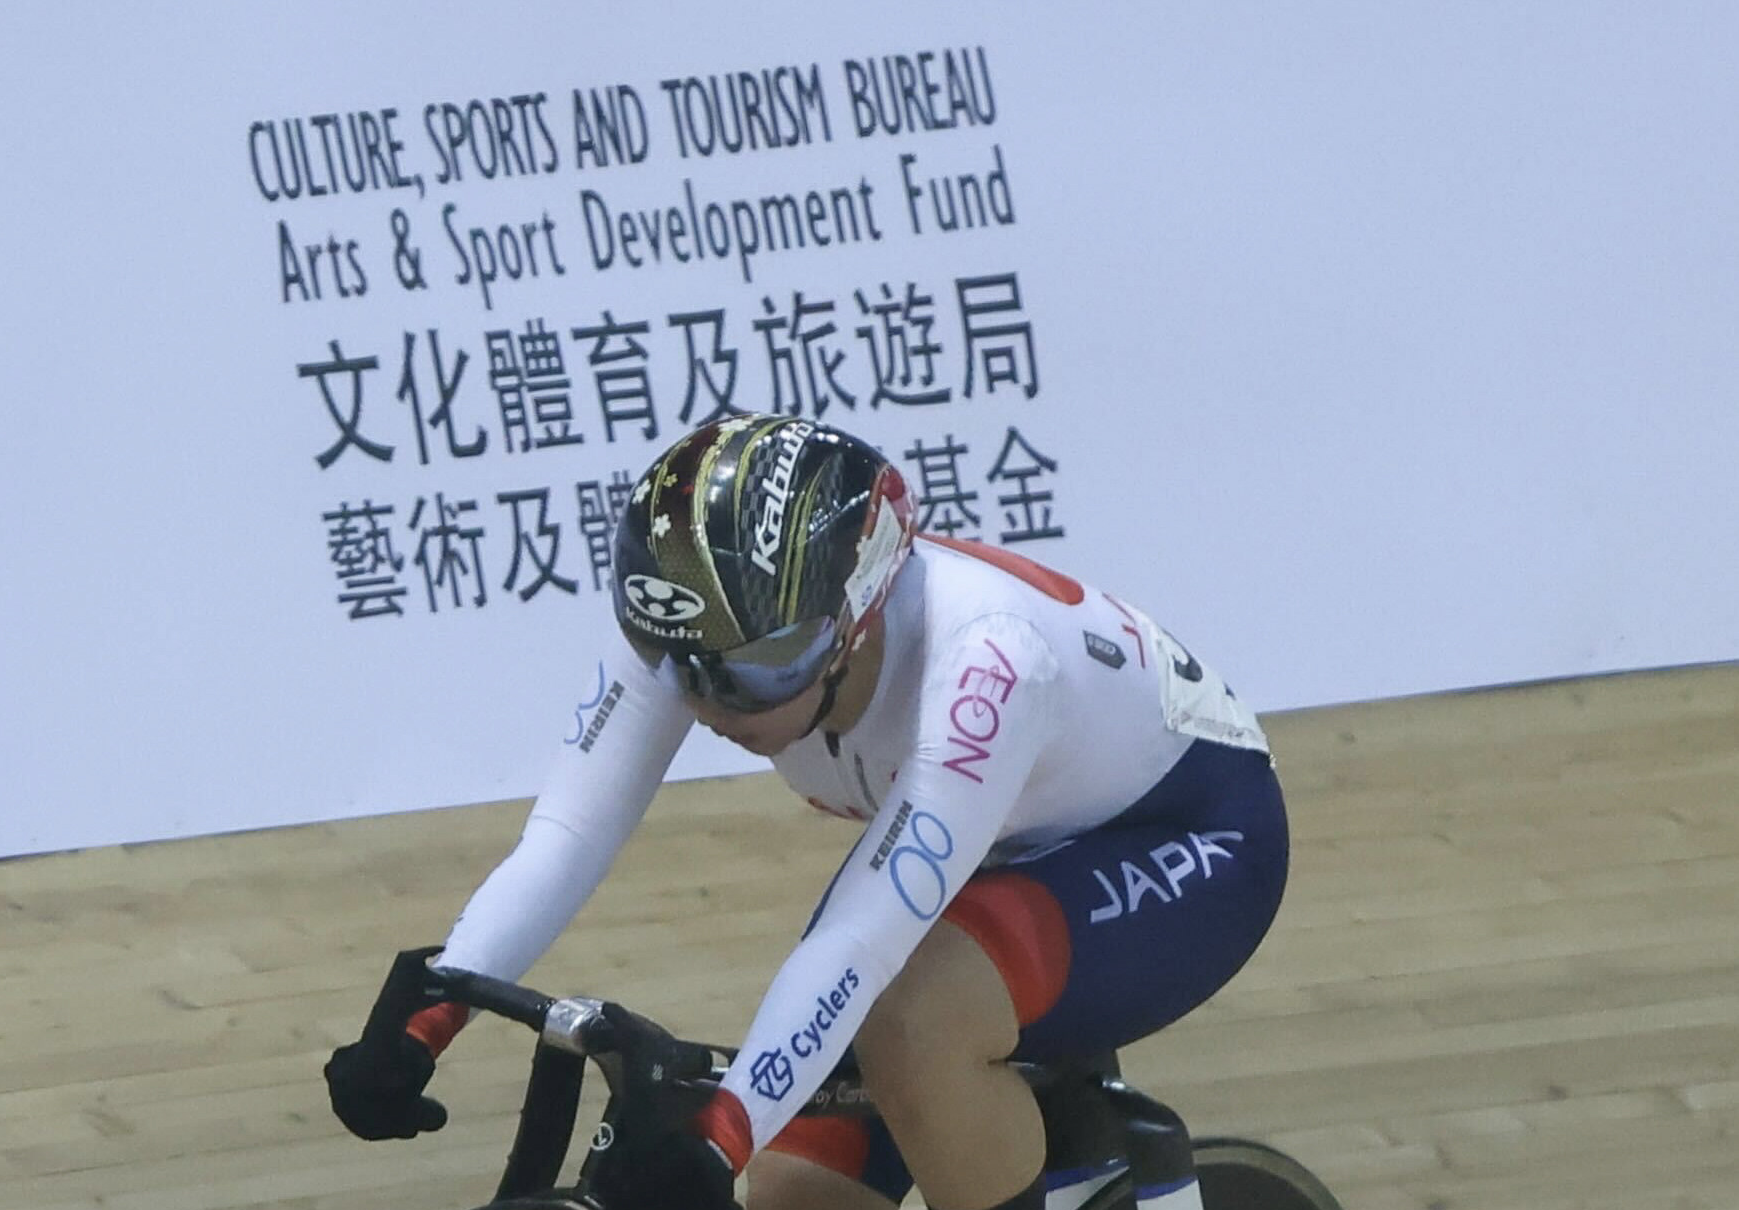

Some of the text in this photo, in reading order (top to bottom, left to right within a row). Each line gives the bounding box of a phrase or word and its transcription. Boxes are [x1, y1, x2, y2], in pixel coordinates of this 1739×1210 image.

[249, 47, 996, 203] CULTURE, SPORTS AND TOURISM BUREAU
[278, 145, 1016, 311] Arts & Sport Development Fund
[297, 272, 1040, 470] 文化體育及旅遊局
[1089, 826, 1245, 925] JAPA
[790, 967, 860, 1058] Cyclers
